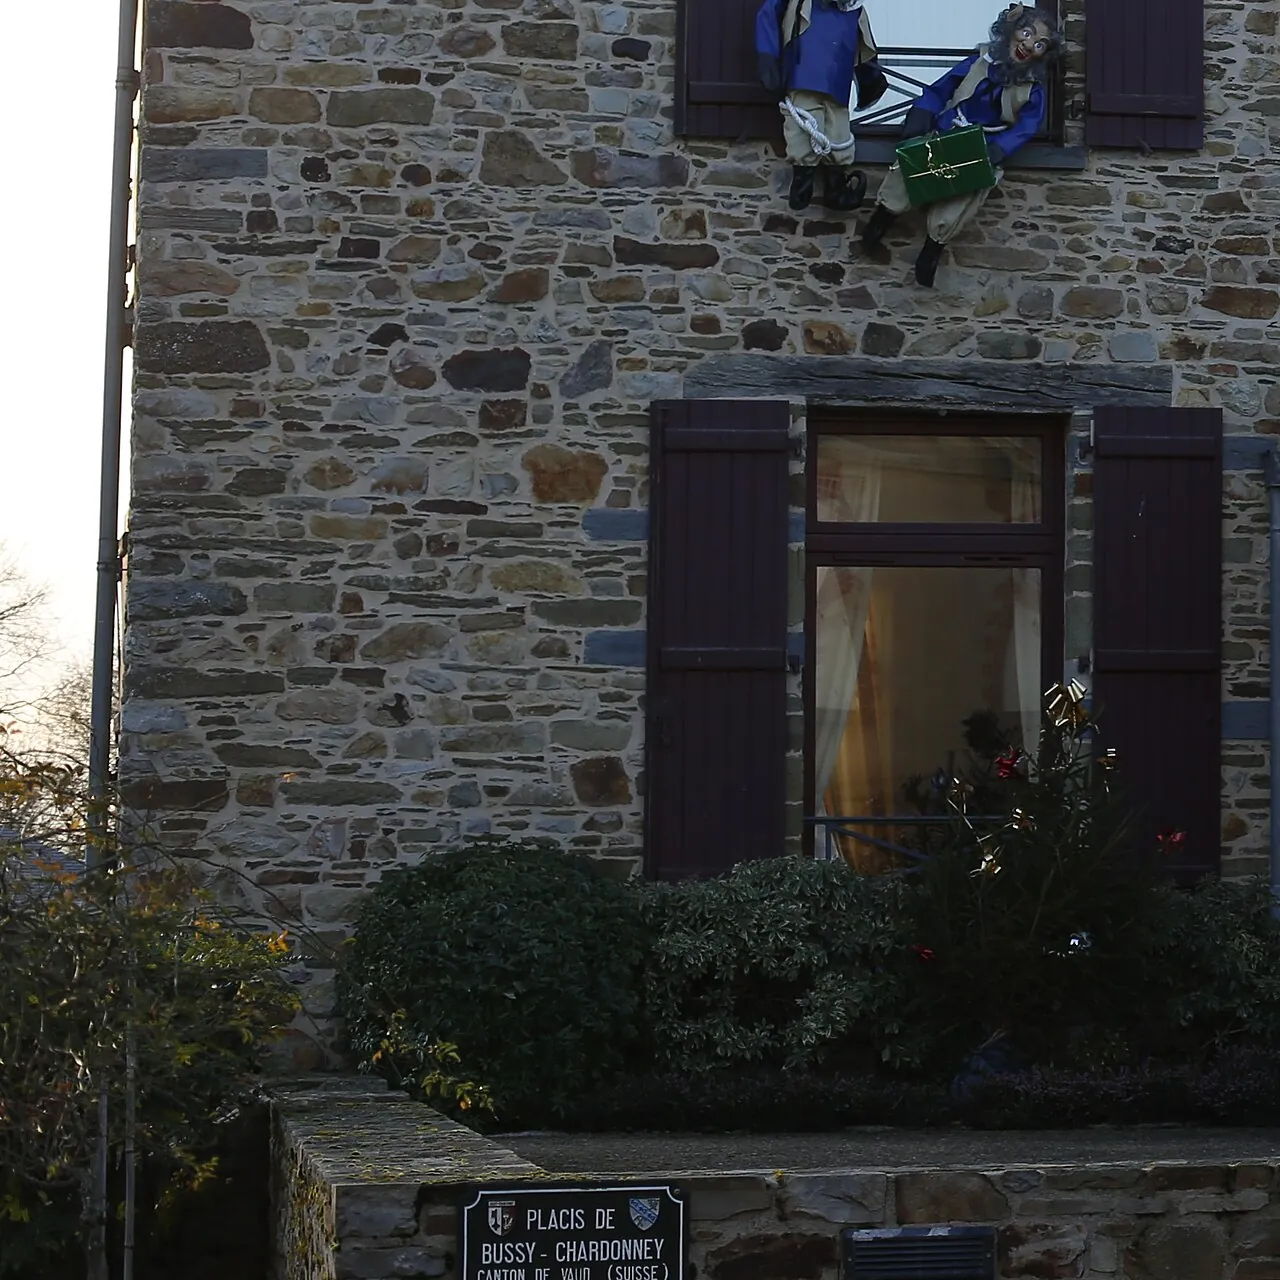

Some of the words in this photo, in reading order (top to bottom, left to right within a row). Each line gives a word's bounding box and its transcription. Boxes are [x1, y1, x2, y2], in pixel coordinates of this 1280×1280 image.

[526, 1208, 585, 1230] PLACIS
[595, 1208, 616, 1230] DE
[482, 1242, 536, 1264] BUSSY
[555, 1238, 665, 1262] CHARDONNEY
[477, 1269, 525, 1280] CANTON
